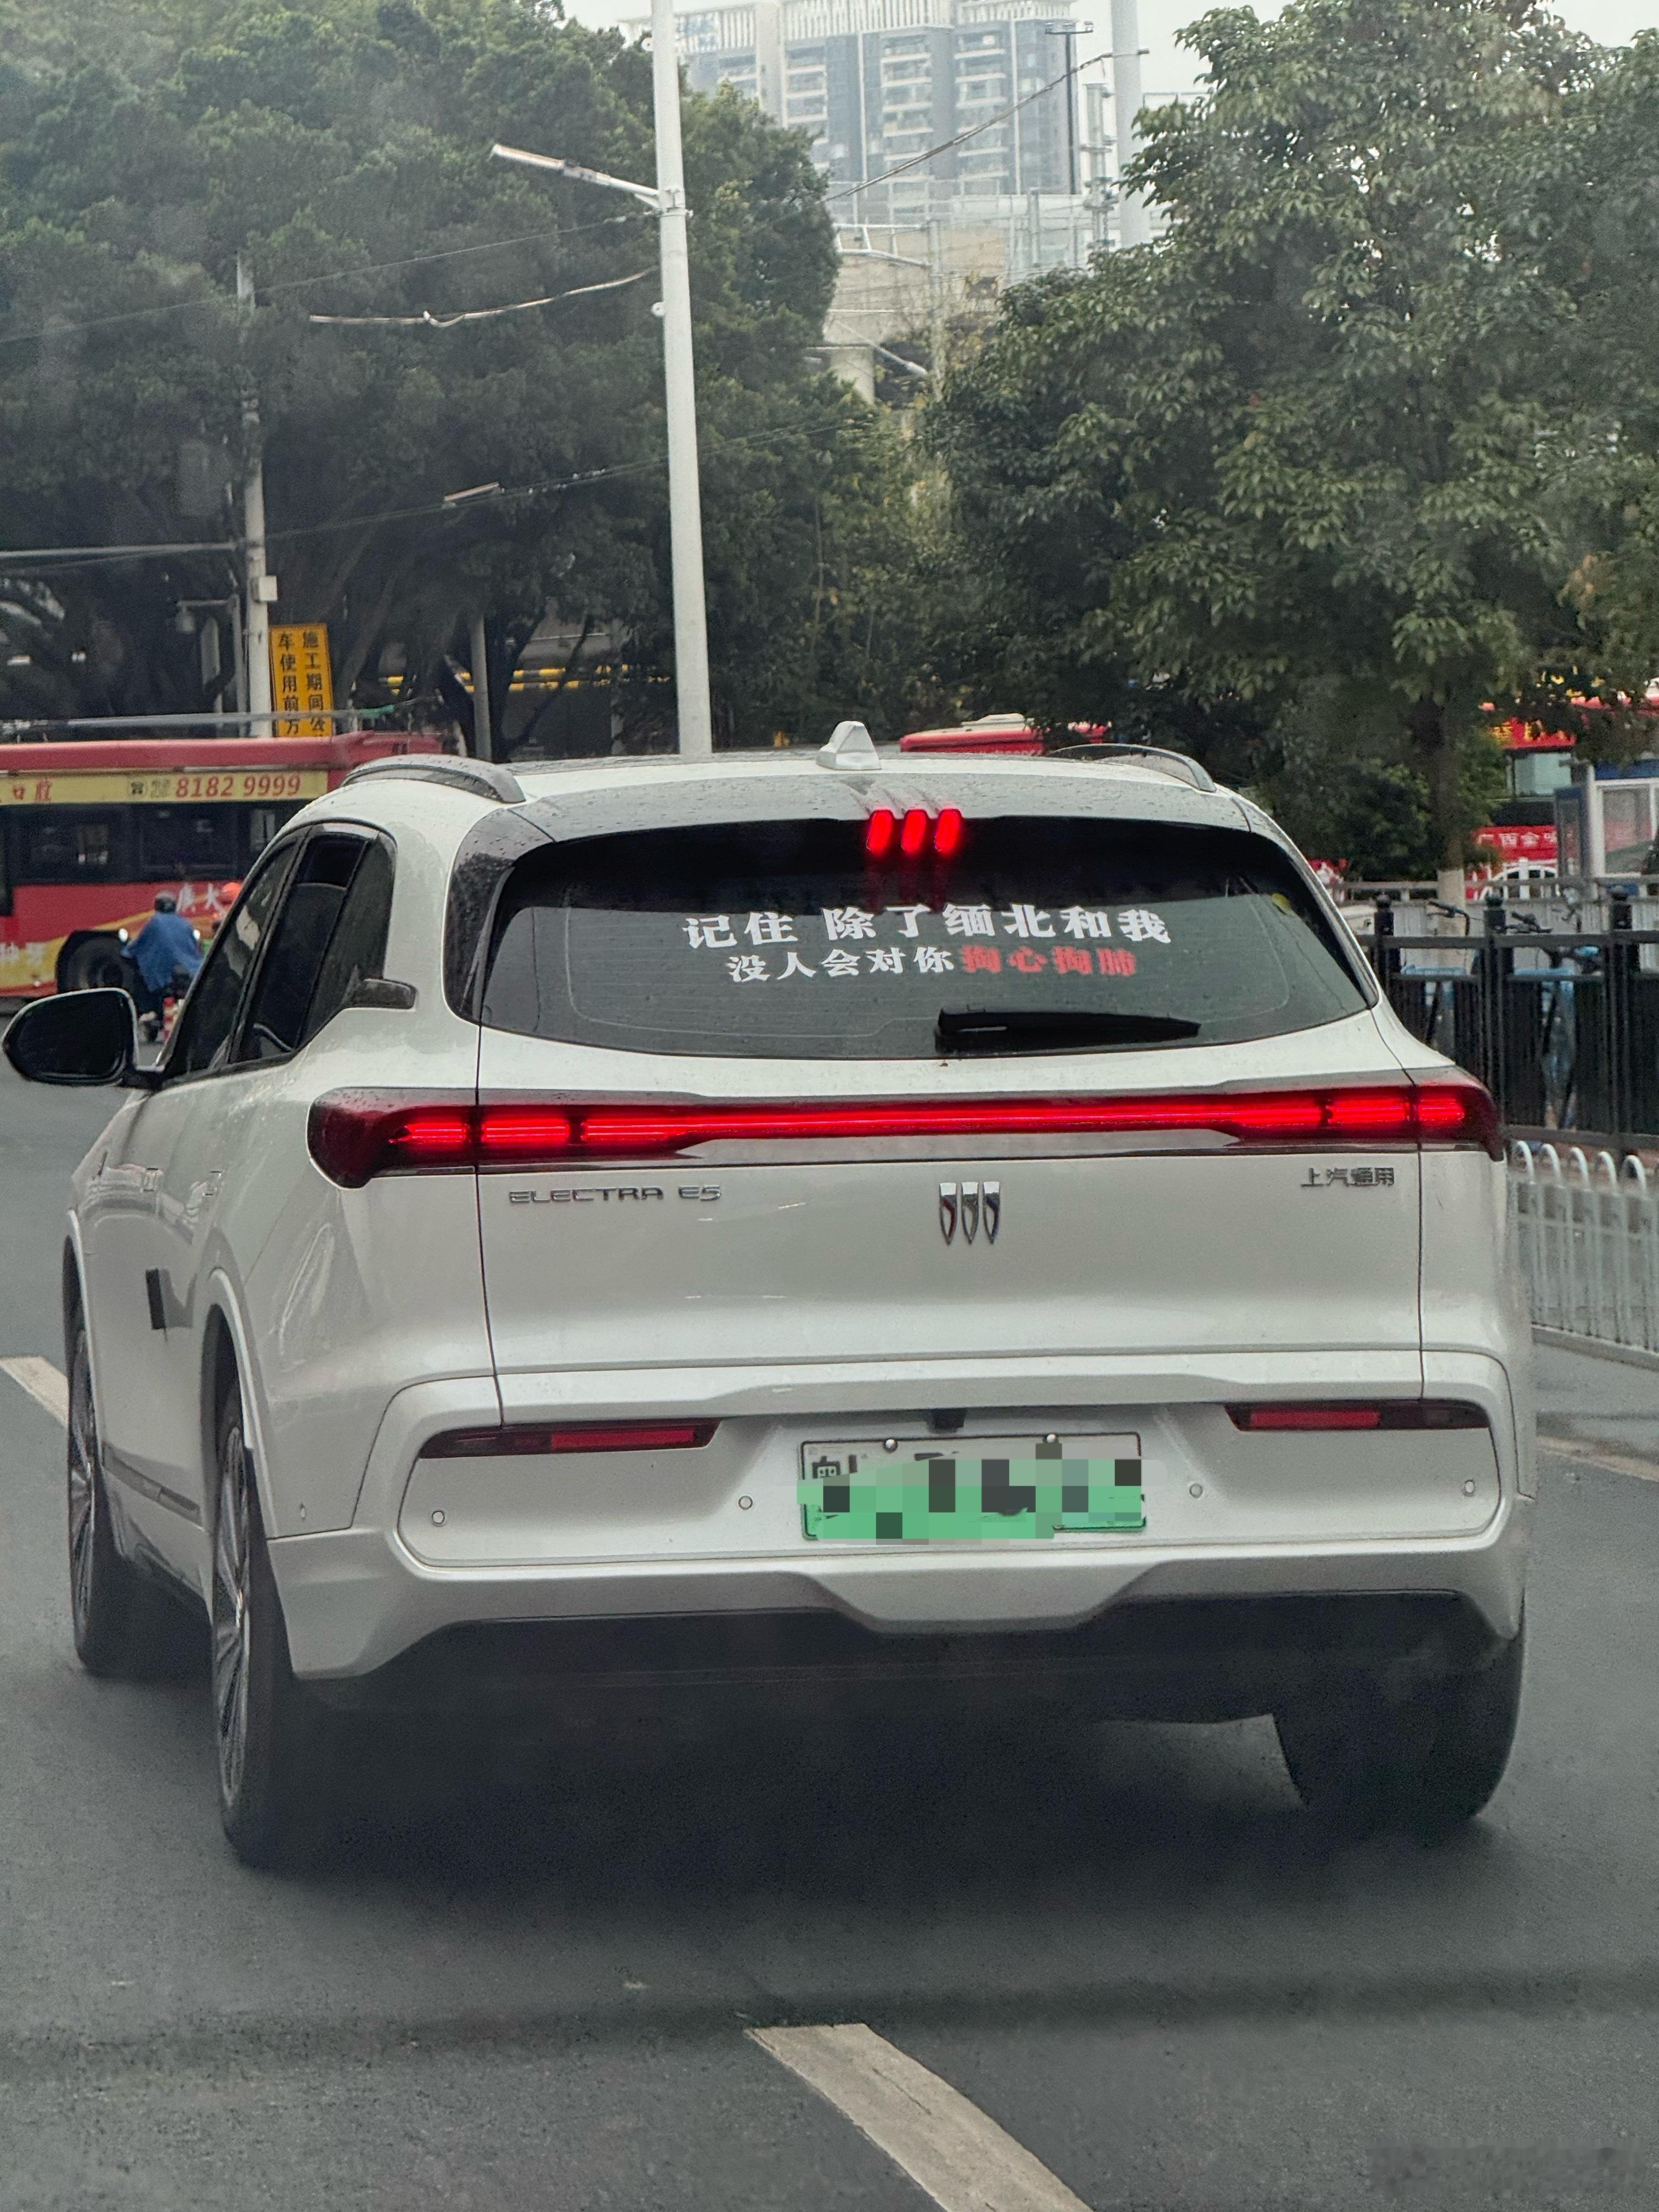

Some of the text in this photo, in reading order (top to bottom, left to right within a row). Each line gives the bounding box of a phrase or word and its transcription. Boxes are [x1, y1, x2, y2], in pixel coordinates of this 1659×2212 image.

[302, 631, 326, 737] 施工期间公
[176, 775, 234, 798] 8182
[243, 774, 301, 797] 9999
[682, 903, 1172, 950] 记住 除了缅北和我
[1300, 1167, 1395, 1188] 上汽通用
[509, 1184, 723, 1204] ELECTRA E5
